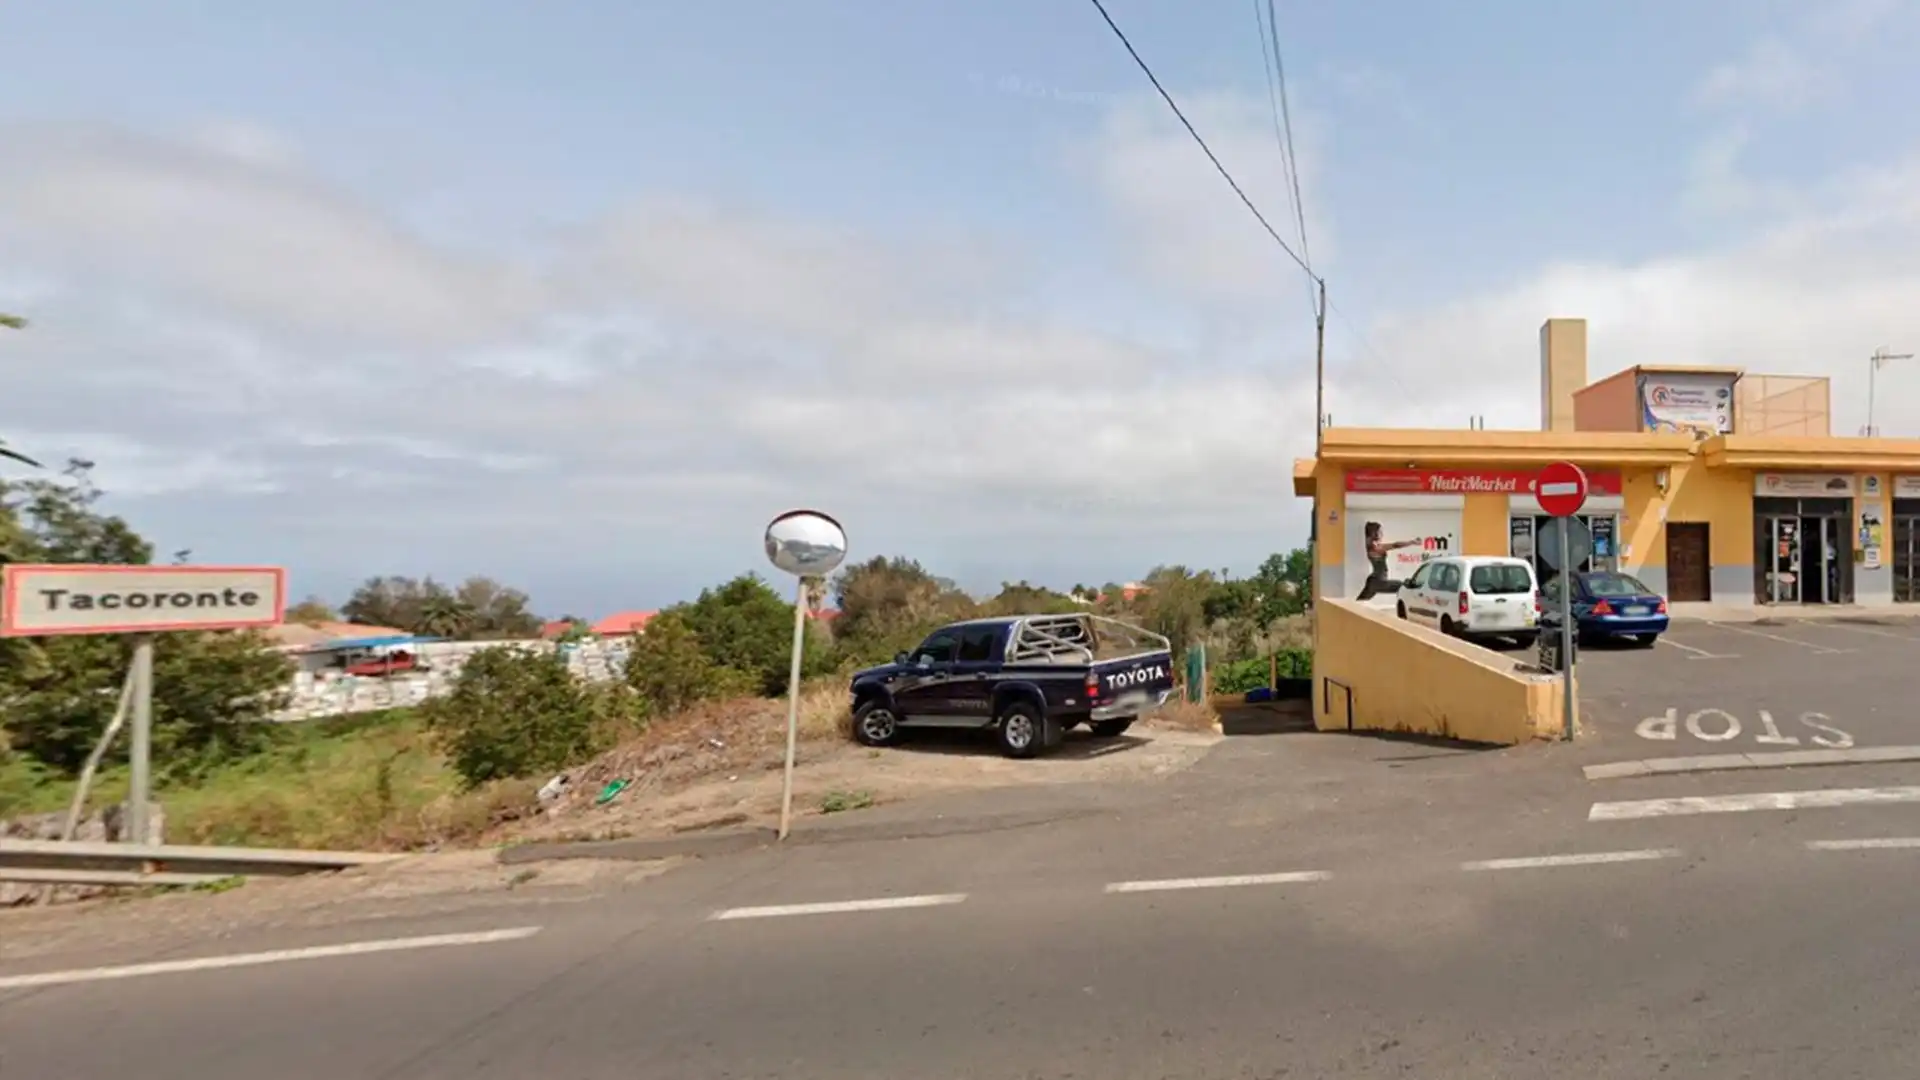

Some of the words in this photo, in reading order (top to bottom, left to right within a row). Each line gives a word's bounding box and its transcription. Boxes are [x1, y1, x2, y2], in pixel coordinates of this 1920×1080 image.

[38, 587, 260, 611] Tacoronte
[1106, 666, 1164, 689] TOYOTA
[1635, 708, 1854, 748] STOP
